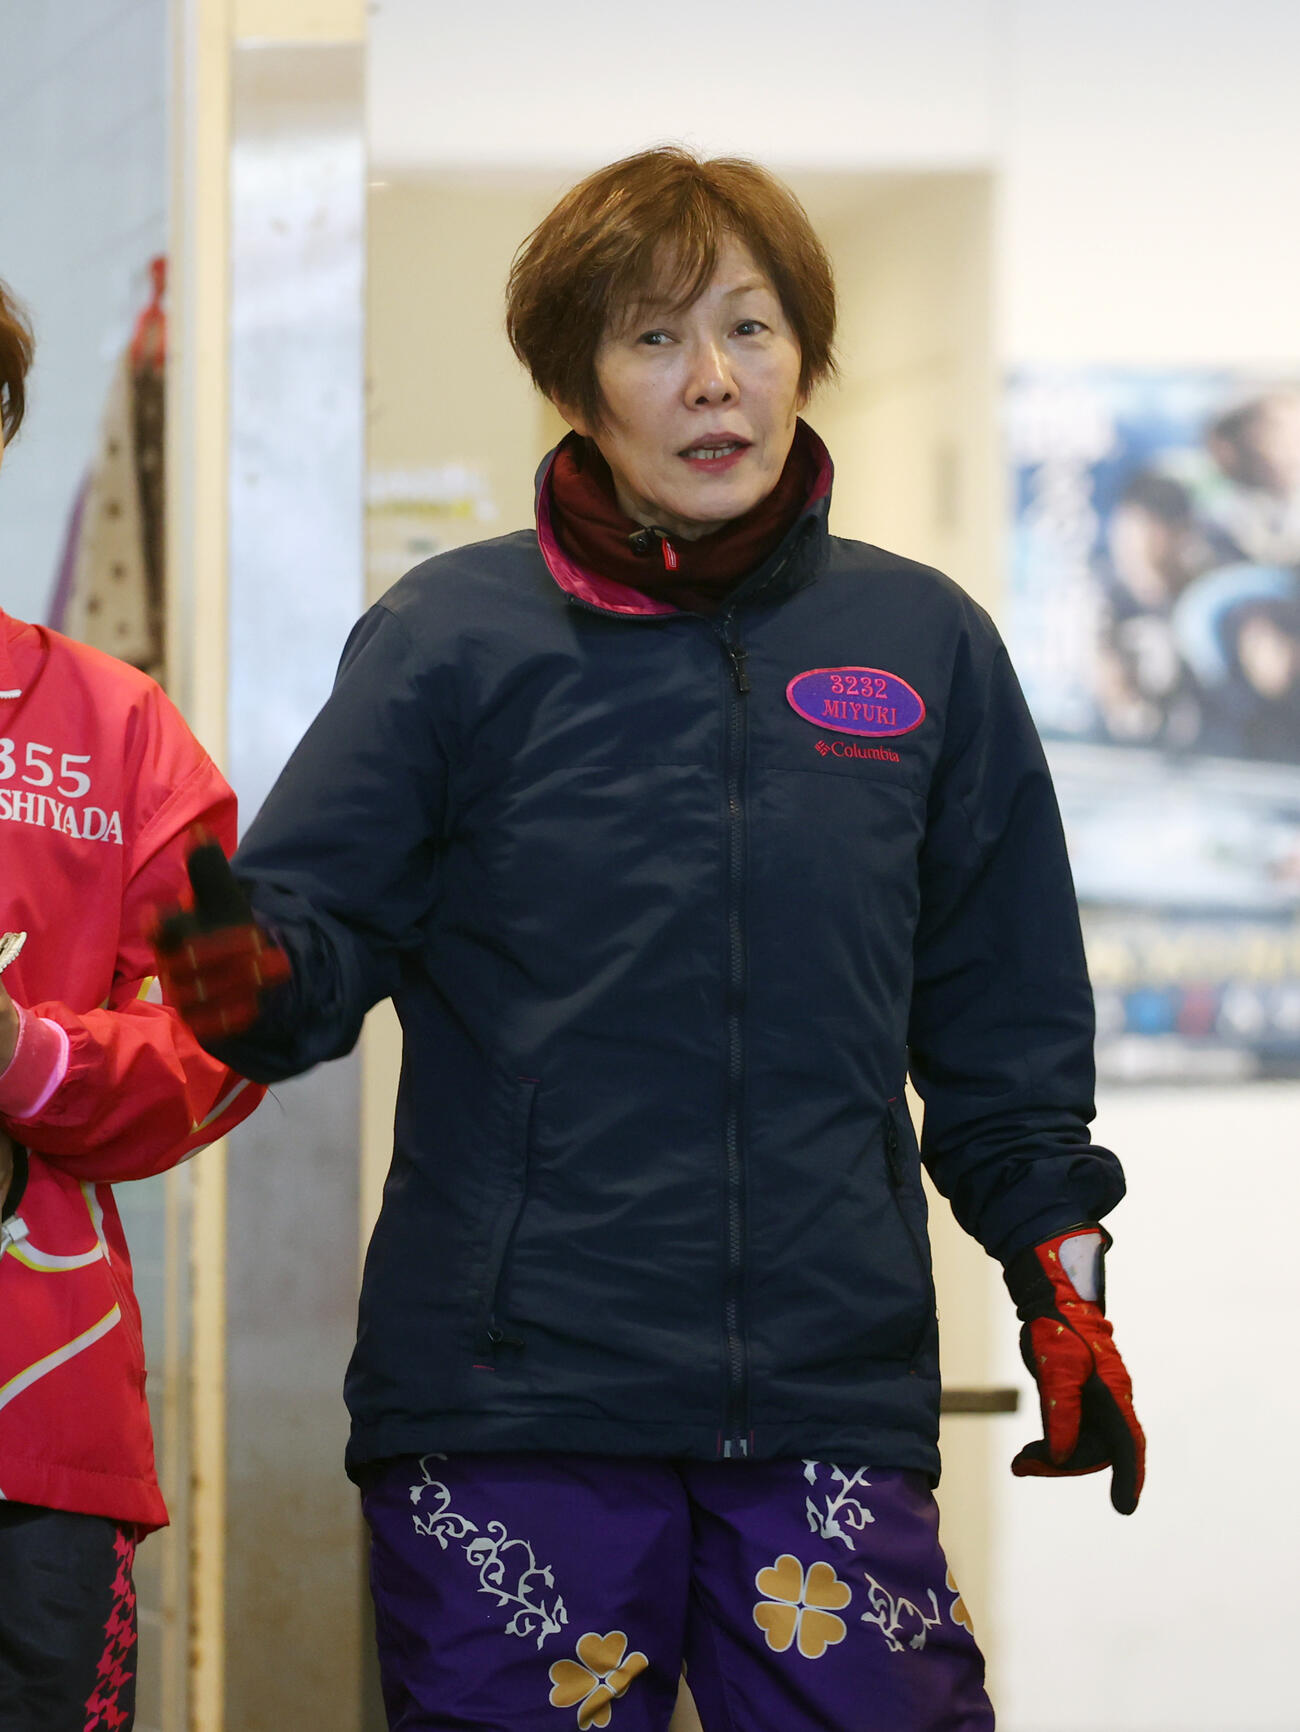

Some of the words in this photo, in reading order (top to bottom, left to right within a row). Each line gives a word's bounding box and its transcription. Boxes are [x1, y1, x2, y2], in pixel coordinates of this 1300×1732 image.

[830, 674, 888, 699] 3232
[822, 699, 897, 726] MIYUKI
[831, 741, 900, 762] Columbia
[0, 788, 123, 845] SHIYADA
